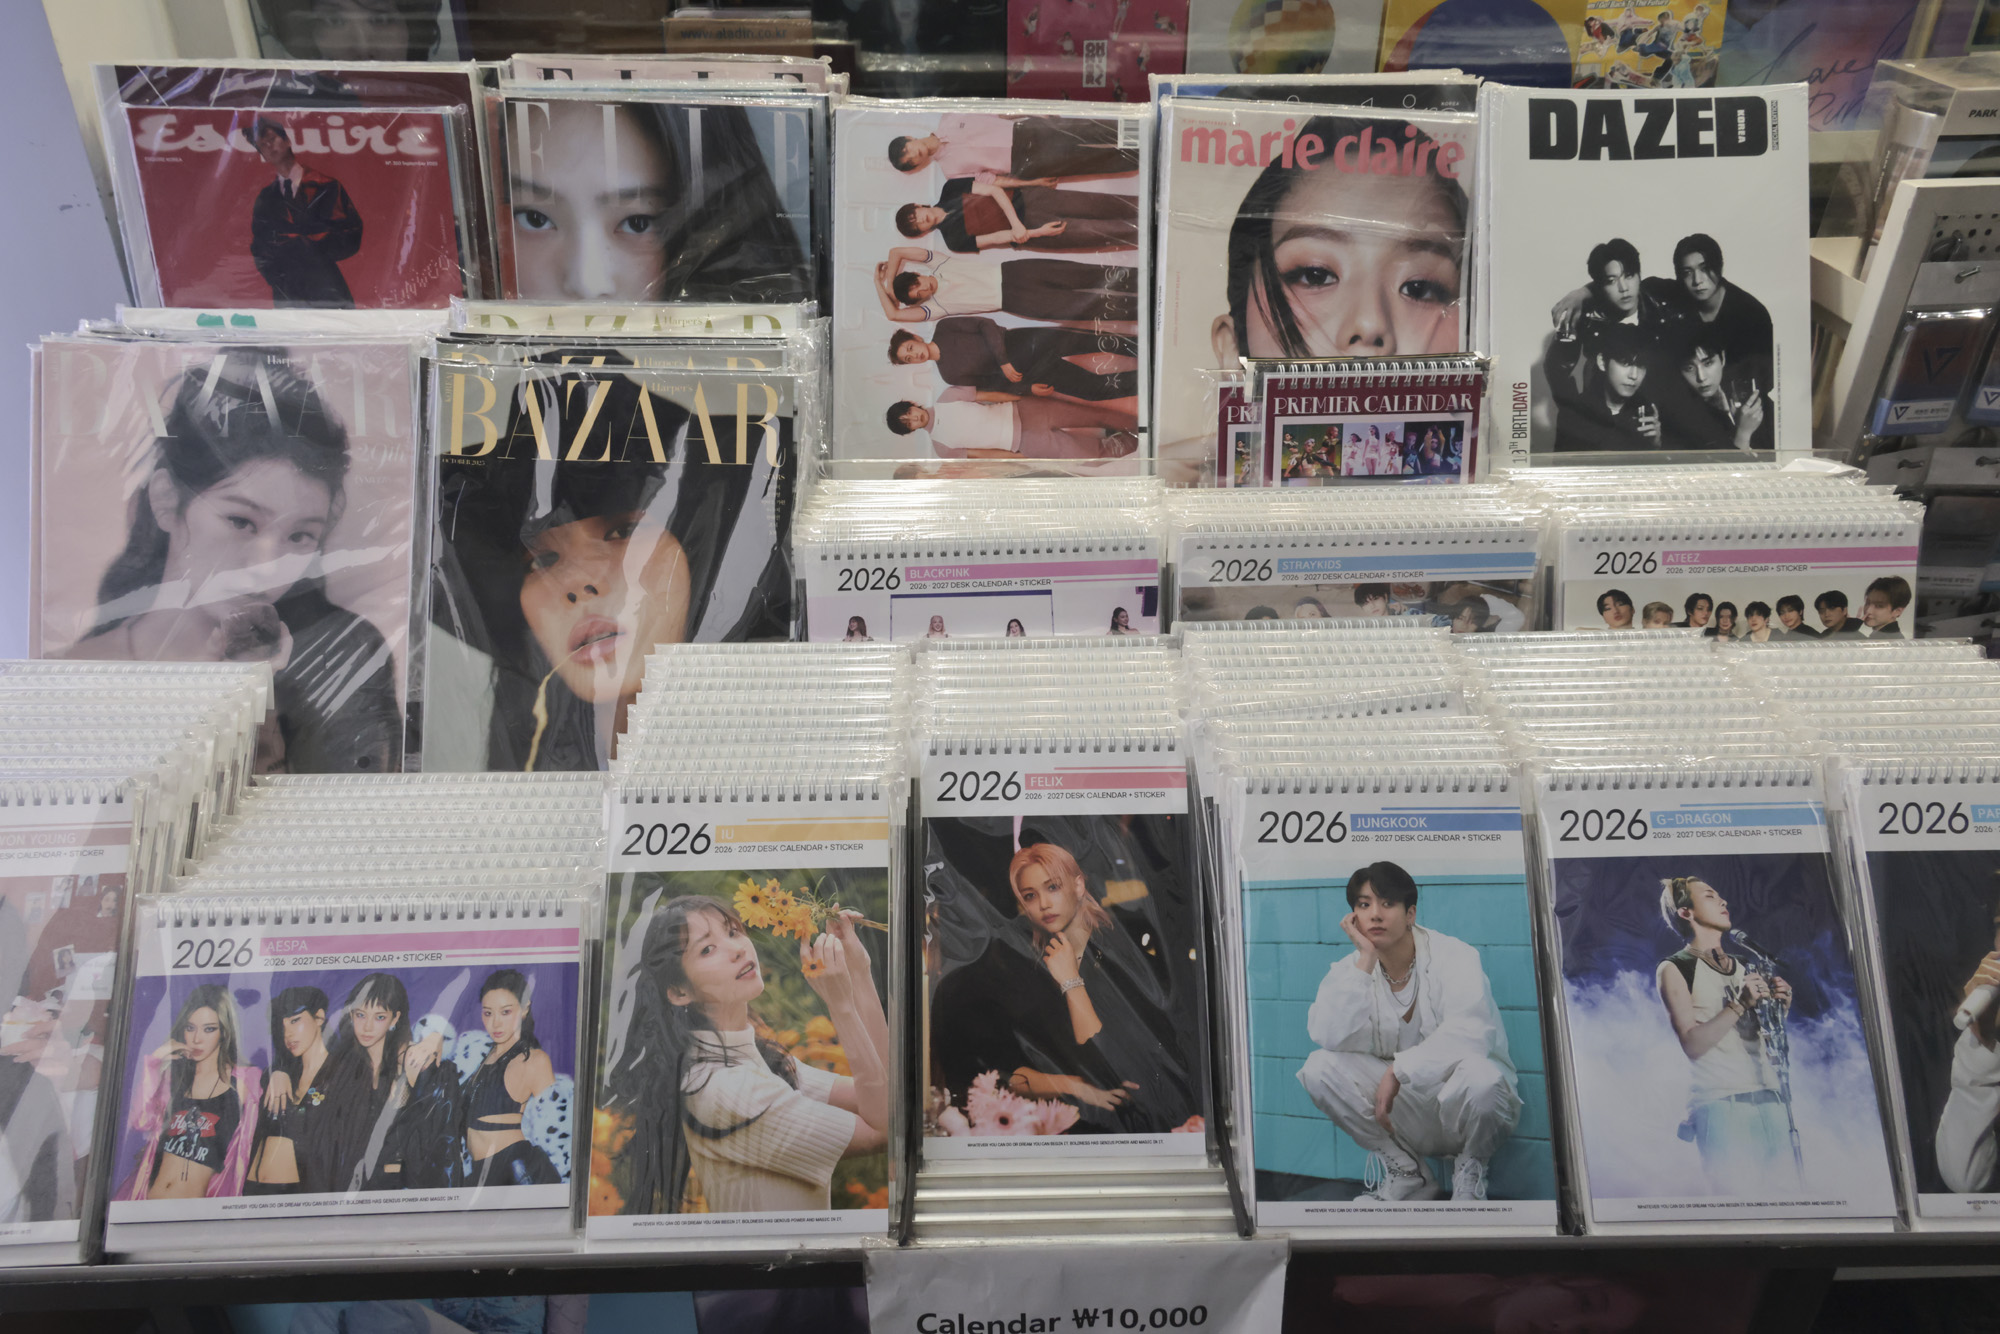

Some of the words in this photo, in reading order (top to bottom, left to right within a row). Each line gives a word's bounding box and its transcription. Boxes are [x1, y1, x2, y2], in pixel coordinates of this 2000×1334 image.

[680, 28, 787, 40] www.aladin.co.kr
[1968, 109, 1998, 118] PARK
[1528, 96, 1768, 160] DAZED
[1737, 109, 1746, 143] KOREA
[1180, 118, 1324, 170] marie
[1334, 124, 1466, 178] claire
[664, 316, 702, 328] Harper's
[652, 382, 693, 395] Harper's
[1274, 396, 1360, 415] PREMIER
[1364, 393, 1473, 413] CALENDAR
[1512, 382, 1528, 438] BIRTHDAY6
[444, 372, 786, 468] BAZAAR
[1282, 560, 1342, 570] STRAYKIDS
[1594, 551, 1658, 574] 2026
[1667, 553, 1700, 563] ATEEZ
[910, 567, 970, 578] BLACKPINK
[1209, 558, 1273, 582] 2026
[1728, 564, 1769, 573] CALENDAR
[1776, 564, 1807, 572] STICKER
[838, 567, 902, 591] 2026
[971, 580, 1012, 588] CALENDAR
[1019, 578, 1051, 586] STICKER
[937, 771, 1022, 802] 2026
[1030, 776, 1063, 787] FELIX
[1356, 817, 1428, 828] JUNGKOOK
[1560, 809, 1648, 841] 2026
[1656, 813, 1732, 825] G-DRAGON
[1879, 802, 1969, 834] 2026
[1258, 811, 1347, 843] 2026
[1718, 829, 1761, 837] CALENDAR
[1768, 828, 1802, 836] STICKER
[31, 833, 76, 845] YOUNG
[621, 823, 711, 855] 2026
[721, 829, 734, 840] IU
[1467, 833, 1501, 841] STICKER
[757, 844, 778, 852] DESK
[779, 843, 822, 851] CALENDAR
[172, 937, 253, 969] 2026
[266, 939, 308, 953] AESPA
[264, 957, 285, 966] 2026
[292, 956, 313, 965] 2027
[315, 955, 340, 964] DESK
[342, 953, 393, 964] CALENDAR
[403, 952, 442, 962] STICKER
[916, 1313, 1061, 1334] Calendar
[1072, 1305, 1208, 1332] ₩10,000
